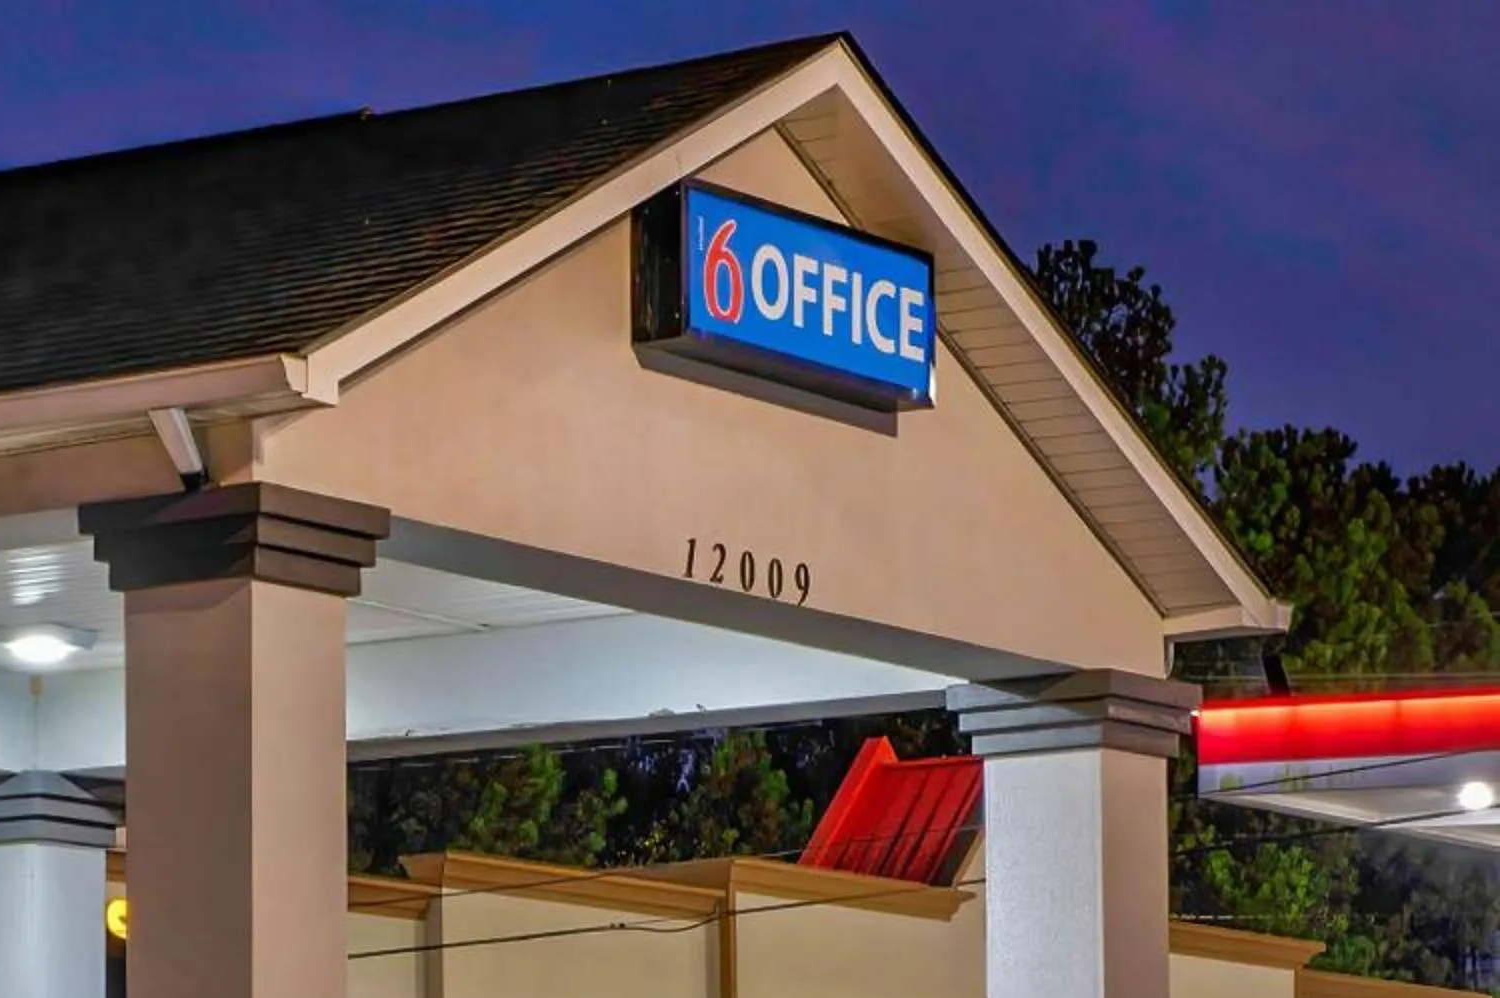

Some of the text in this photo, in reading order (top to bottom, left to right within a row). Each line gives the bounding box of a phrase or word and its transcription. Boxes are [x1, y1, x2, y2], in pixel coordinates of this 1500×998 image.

[703, 218, 925, 363] 6 OFFICE
[683, 538, 810, 608] 12009
